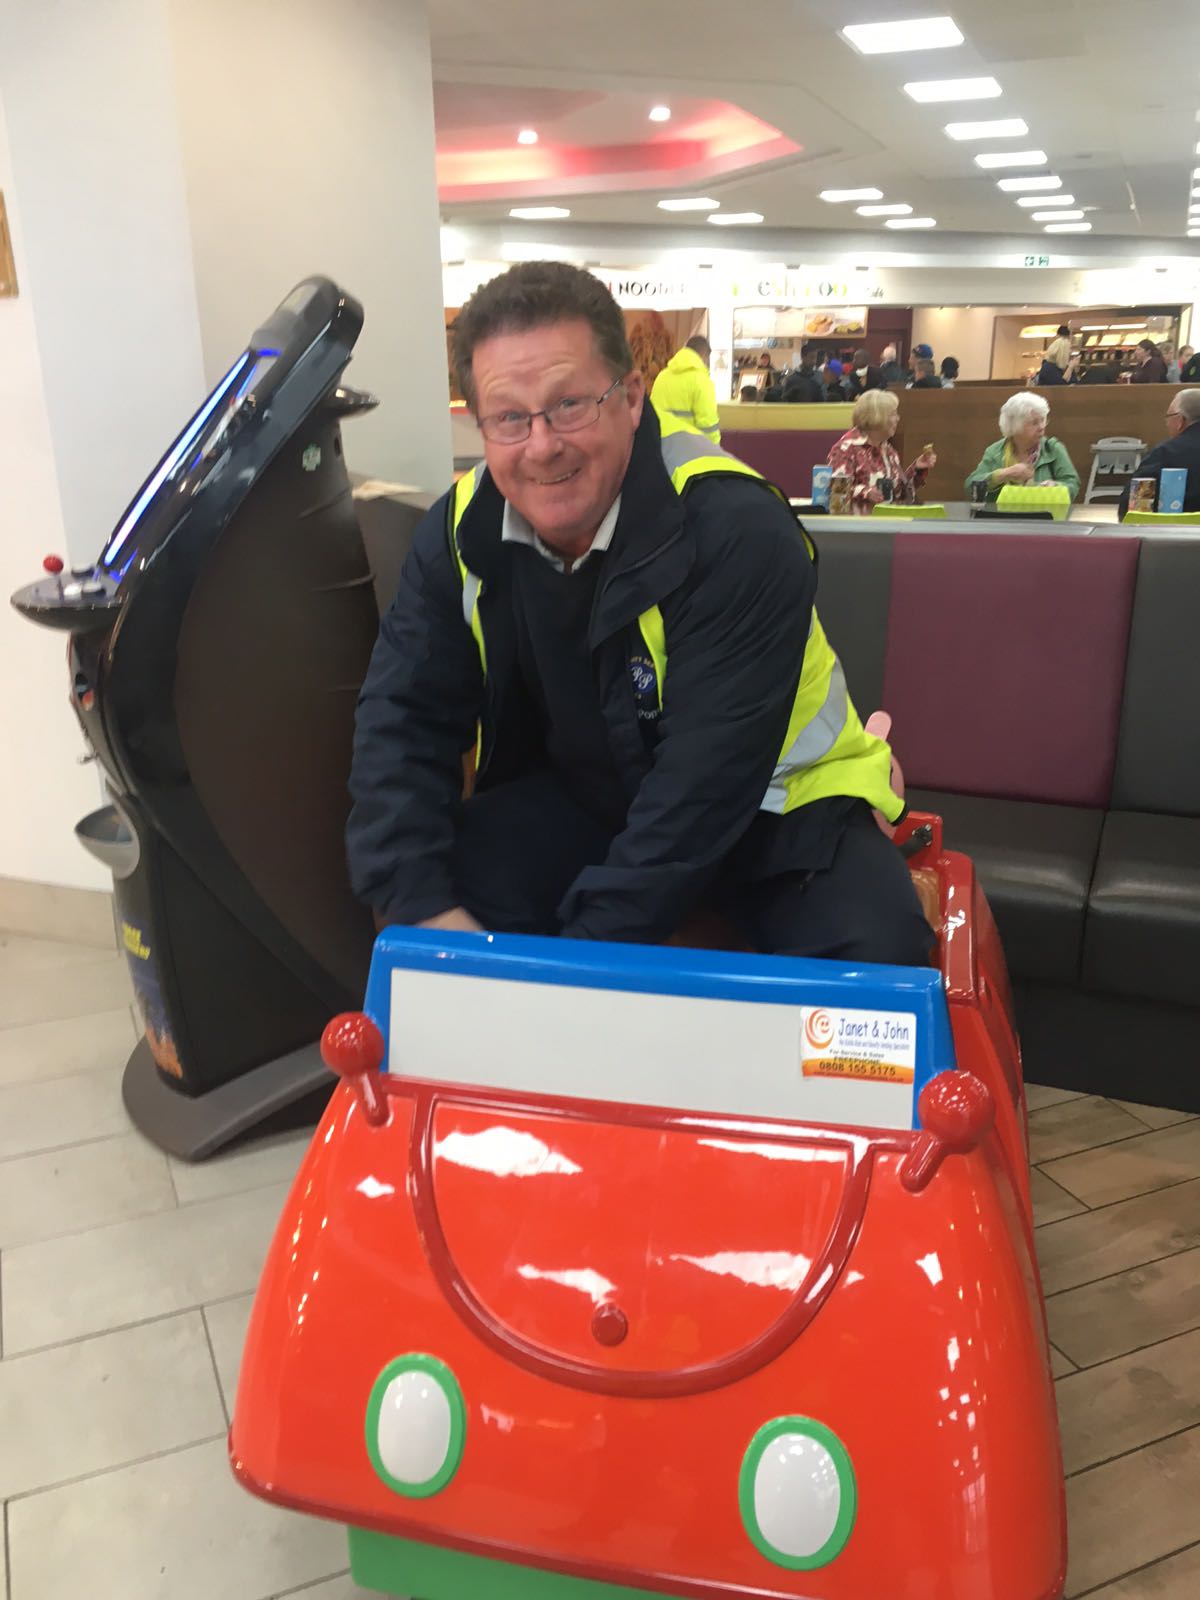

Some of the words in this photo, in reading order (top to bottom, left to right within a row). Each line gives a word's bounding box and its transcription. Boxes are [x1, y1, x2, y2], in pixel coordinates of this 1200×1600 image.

[838, 1018, 868, 1037] Janet
[871, 1020, 879, 1038] &
[883, 1021, 909, 1040] John
[818, 1061, 845, 1072] 0808
